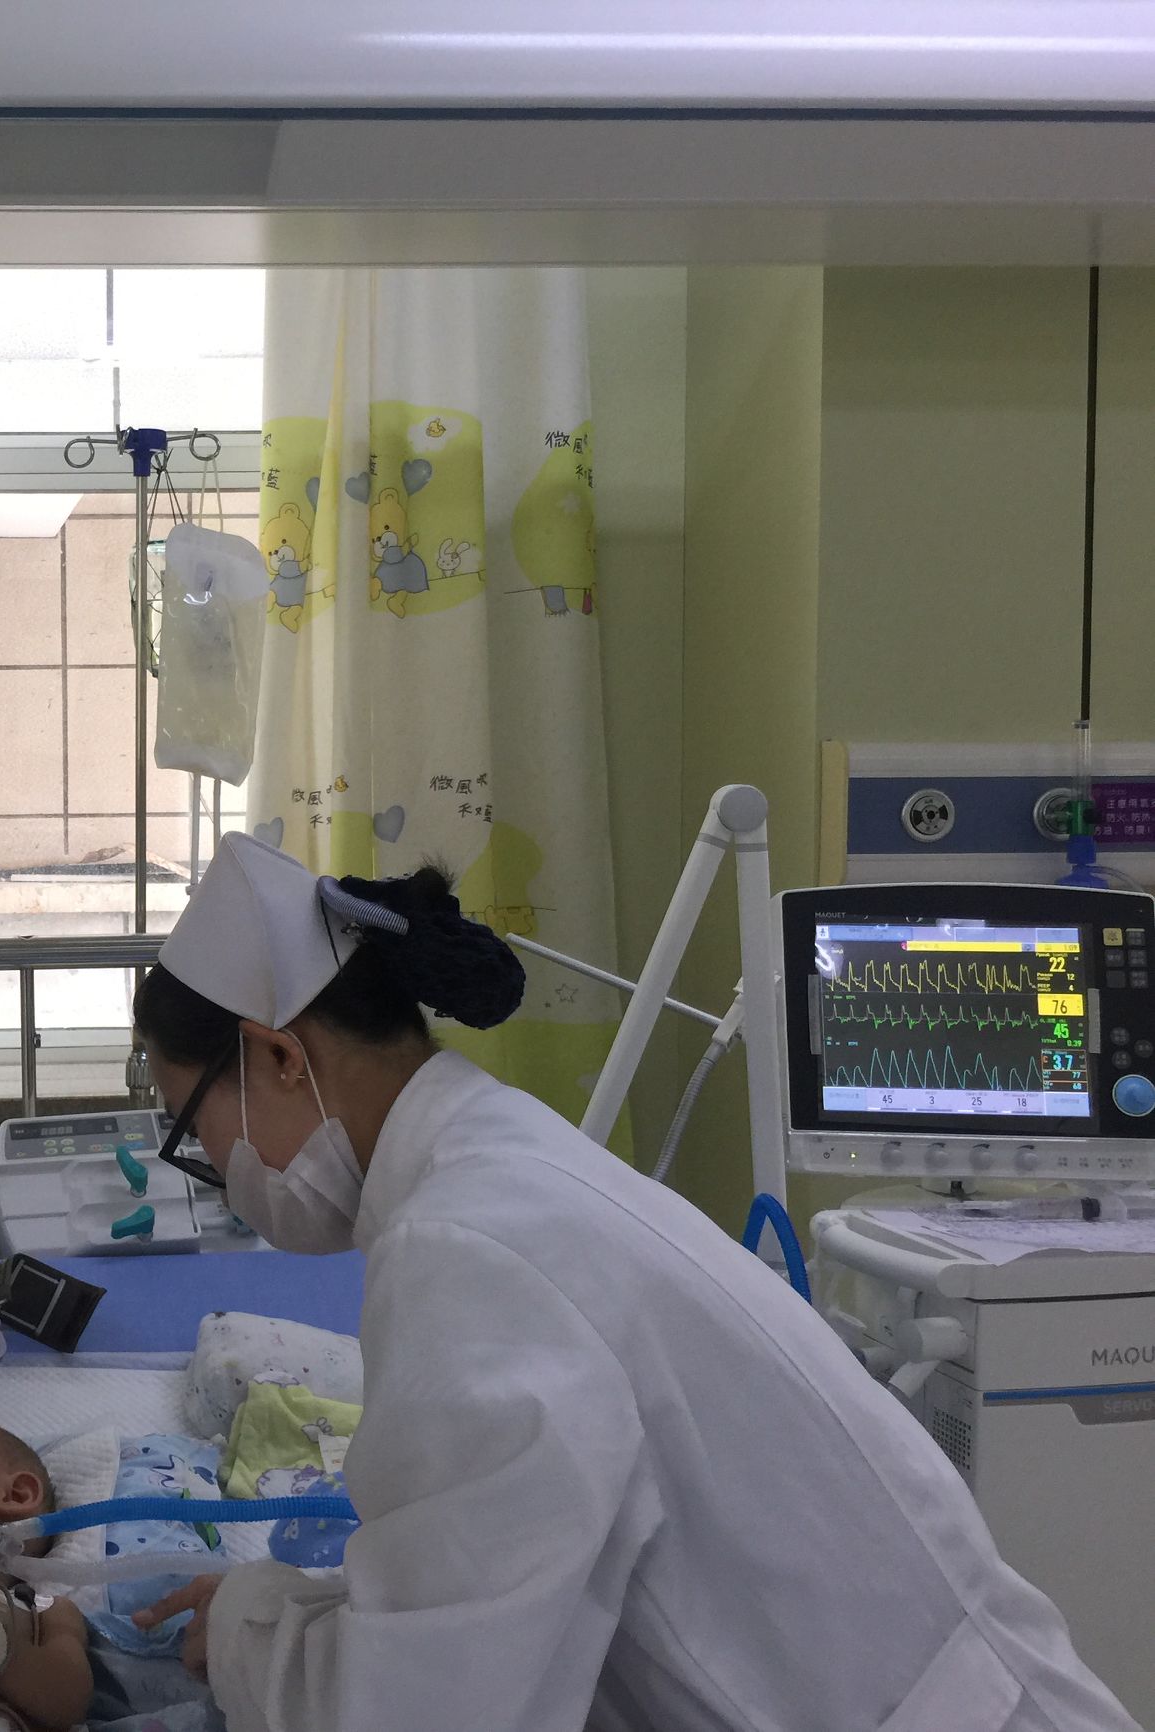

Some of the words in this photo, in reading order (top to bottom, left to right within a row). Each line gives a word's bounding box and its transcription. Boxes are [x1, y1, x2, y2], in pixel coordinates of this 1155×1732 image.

[814, 911, 846, 919] MAQUET
[1049, 956, 1066, 973] 22
[1067, 973, 1075, 981] 12
[1068, 984, 1074, 992] 4
[1052, 999, 1068, 1015] 76
[1053, 1022, 1069, 1039] 45
[1067, 1039, 1082, 1047] 0.39
[1052, 1054, 1073, 1071] 3.7
[882, 1095, 893, 1104] 45
[929, 1096, 935, 1105] 3
[971, 1097, 983, 1106] 25
[1017, 1098, 1027, 1107] 18
[1091, 1346, 1155, 1366] MAQU
